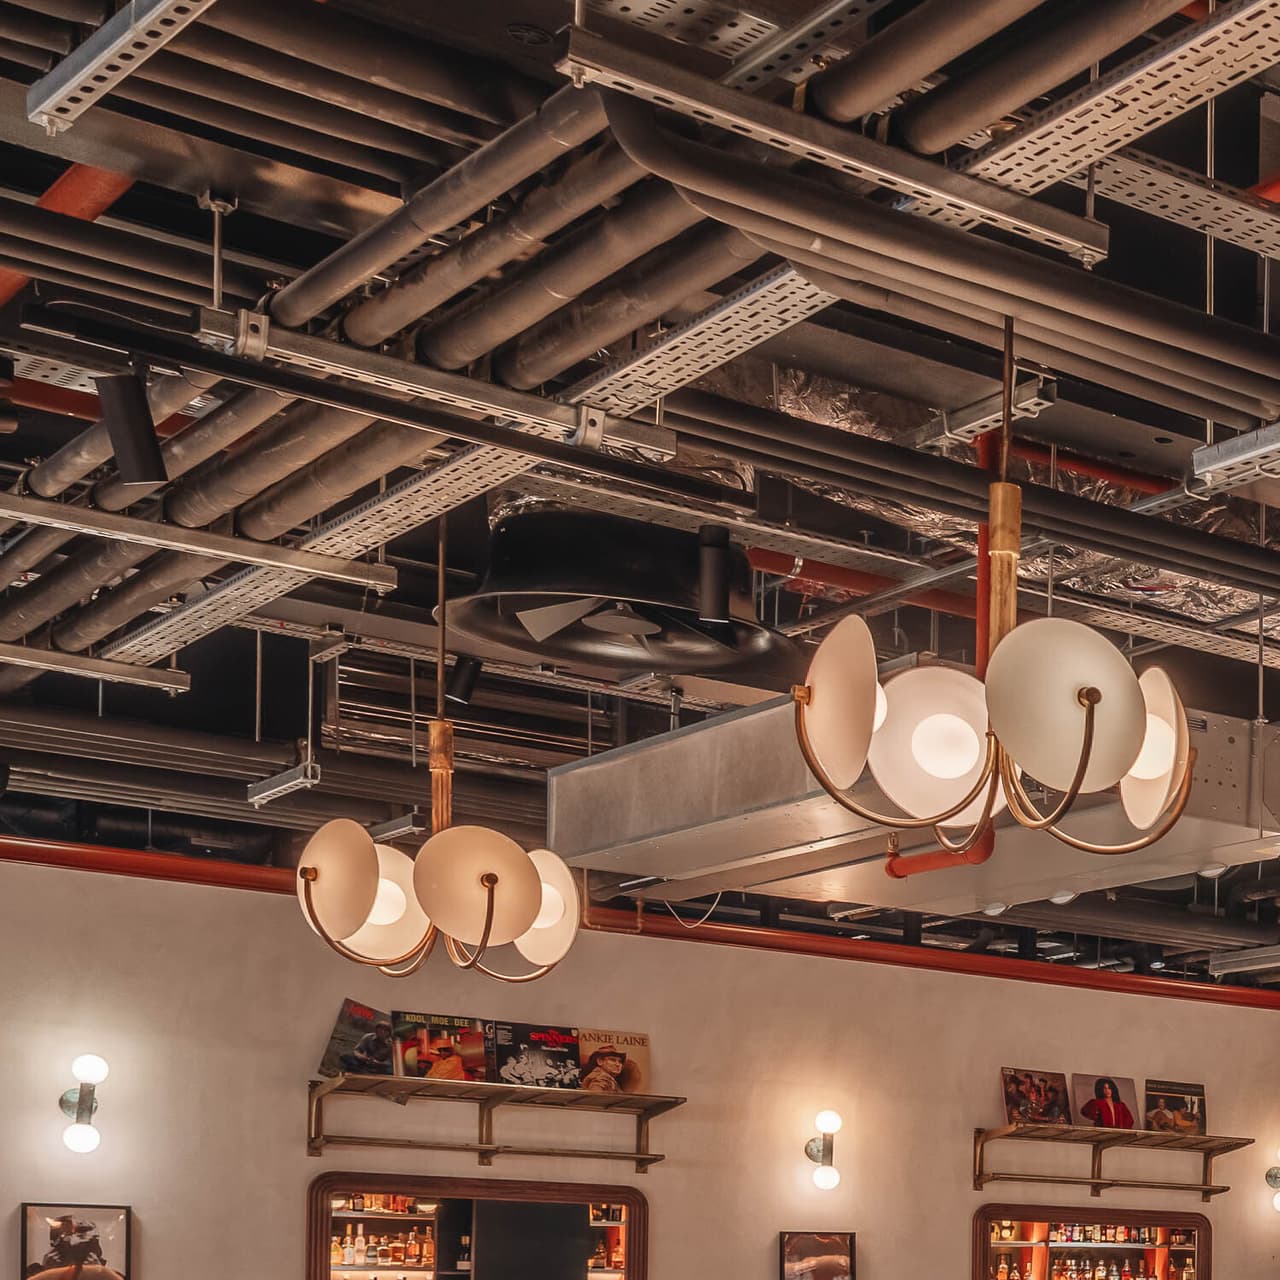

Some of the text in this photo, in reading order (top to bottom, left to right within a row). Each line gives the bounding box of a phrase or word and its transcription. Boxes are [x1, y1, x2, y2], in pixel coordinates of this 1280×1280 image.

[405, 1014, 470, 1027] KOOL MOE DEE
[616, 1035, 648, 1047] LAINE
